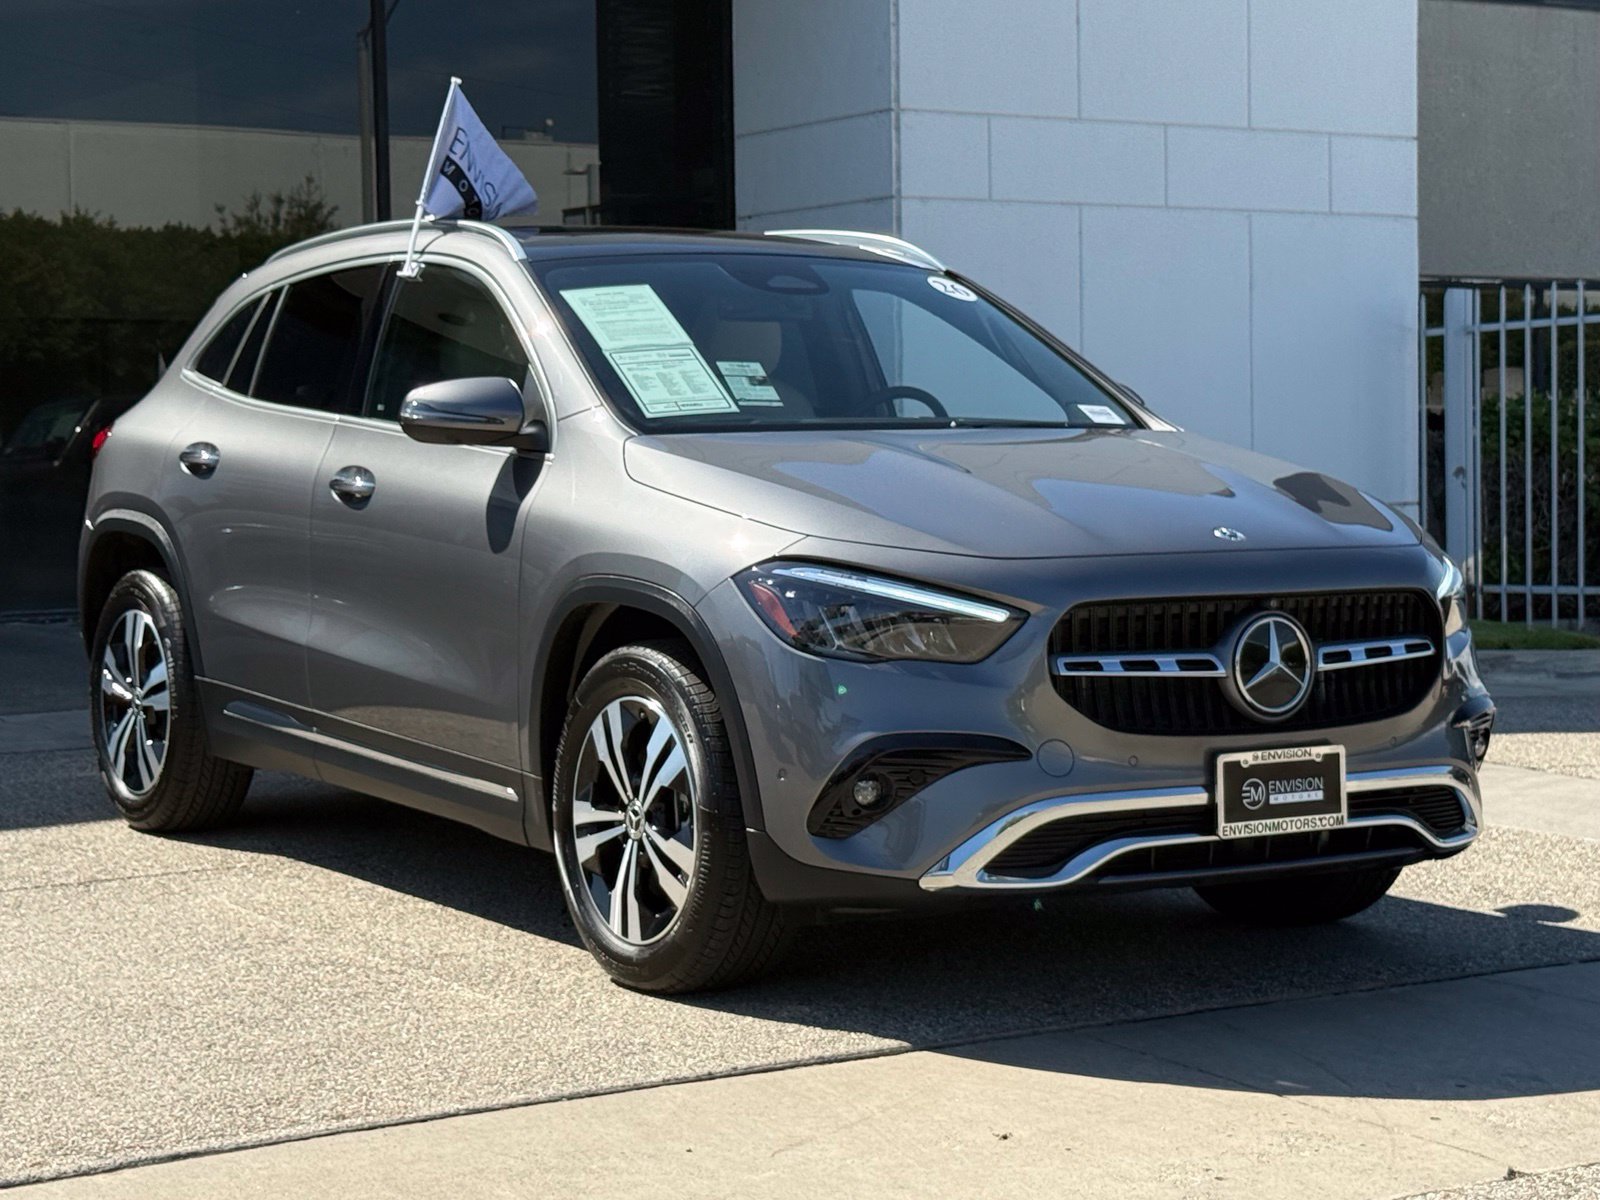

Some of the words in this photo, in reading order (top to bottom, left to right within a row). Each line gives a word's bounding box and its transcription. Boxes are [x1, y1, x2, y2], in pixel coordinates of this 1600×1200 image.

[1261, 748, 1312, 761] ENVISION
[1268, 776, 1324, 794] ENVISION
[1222, 815, 1345, 837] ENVISIONMOTORS.COM
